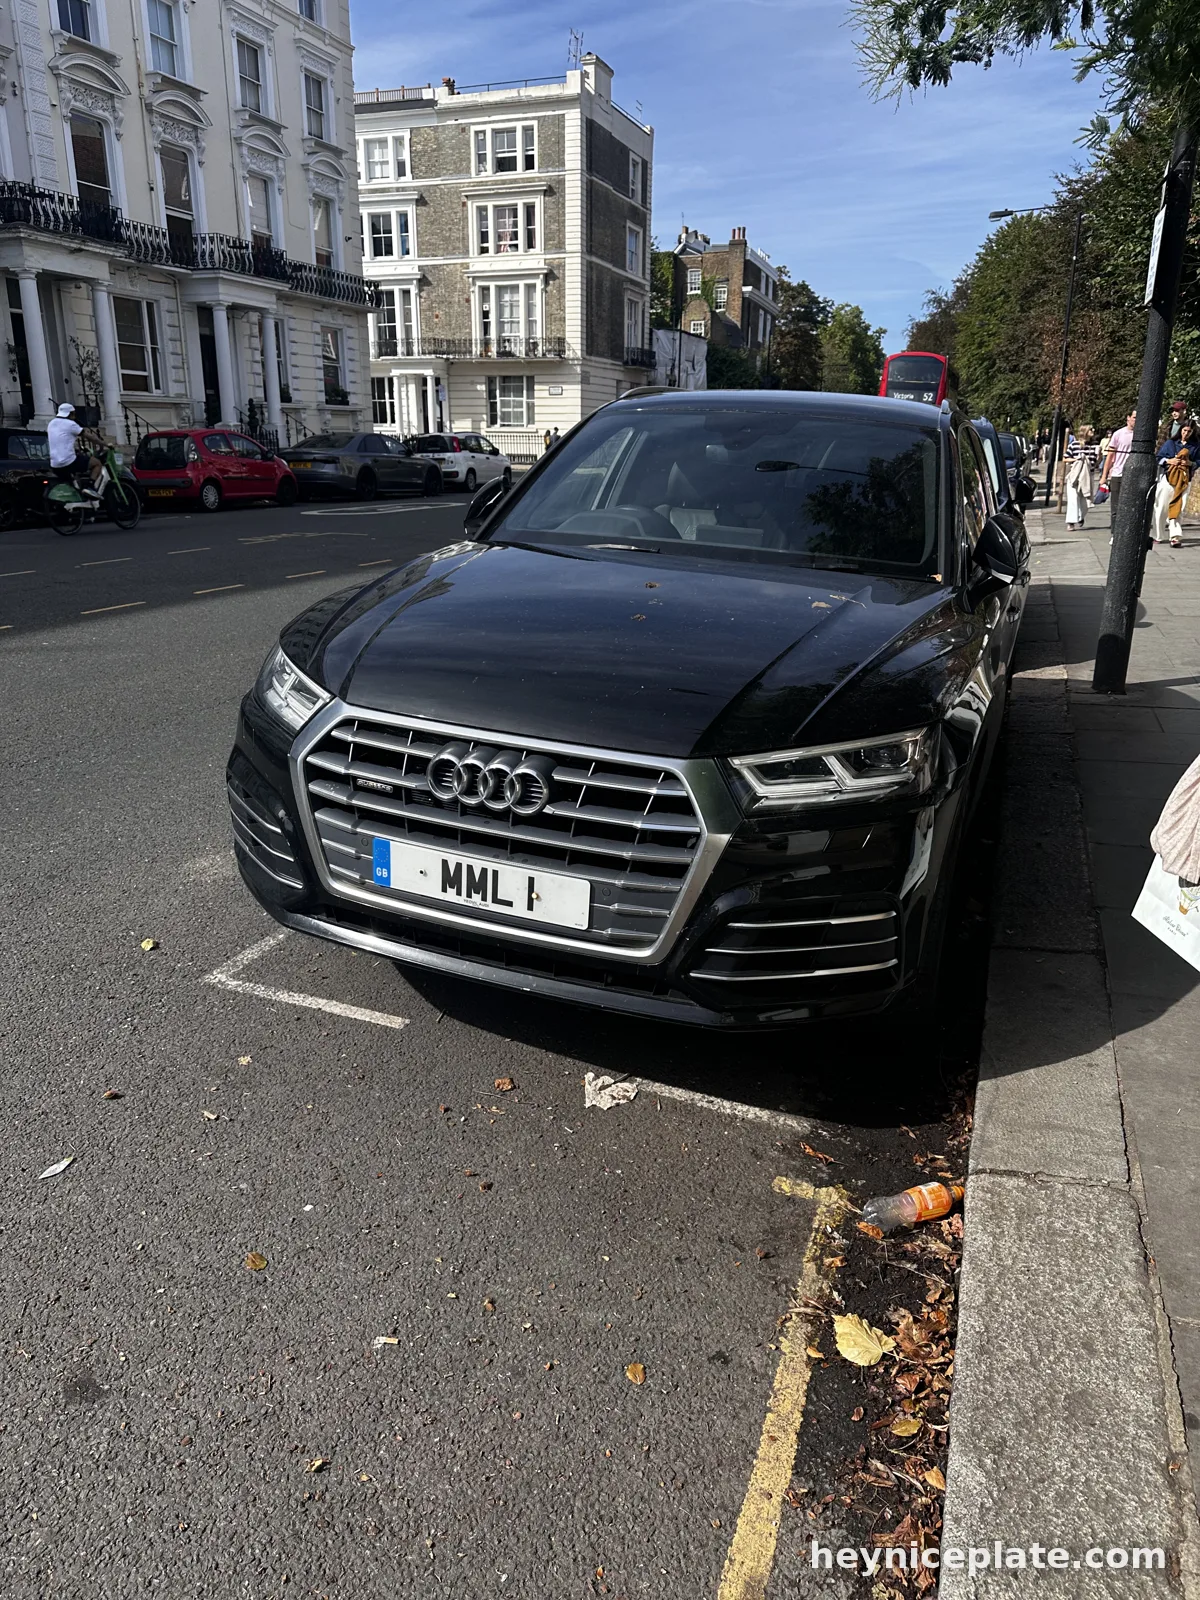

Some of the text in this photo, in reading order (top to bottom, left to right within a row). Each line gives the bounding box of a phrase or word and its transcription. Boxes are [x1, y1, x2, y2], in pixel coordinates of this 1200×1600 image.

[923, 393, 933, 401] 52
[376, 867, 388, 878] GB
[441, 858, 513, 908] MML
